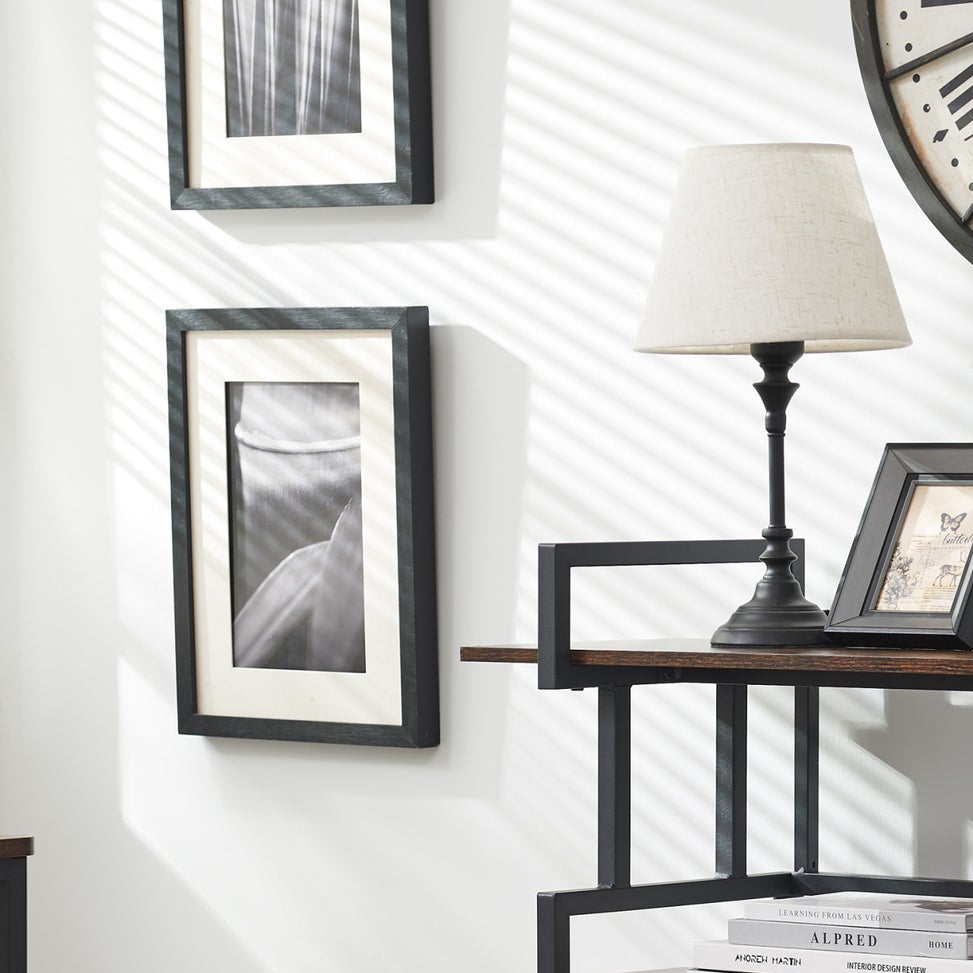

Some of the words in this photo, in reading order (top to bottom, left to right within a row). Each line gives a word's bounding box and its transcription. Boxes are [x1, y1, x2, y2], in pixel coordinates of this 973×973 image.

[778, 908, 819, 919] LEARNING
[822, 911, 844, 920] FROM
[847, 912, 862, 921] LAS
[865, 913, 892, 923] VEGAS
[810, 931, 878, 947] ALPRED
[928, 940, 954, 950] HOME
[846, 961, 877, 972] INTERIOR
[877, 963, 901, 973] DESIGN
